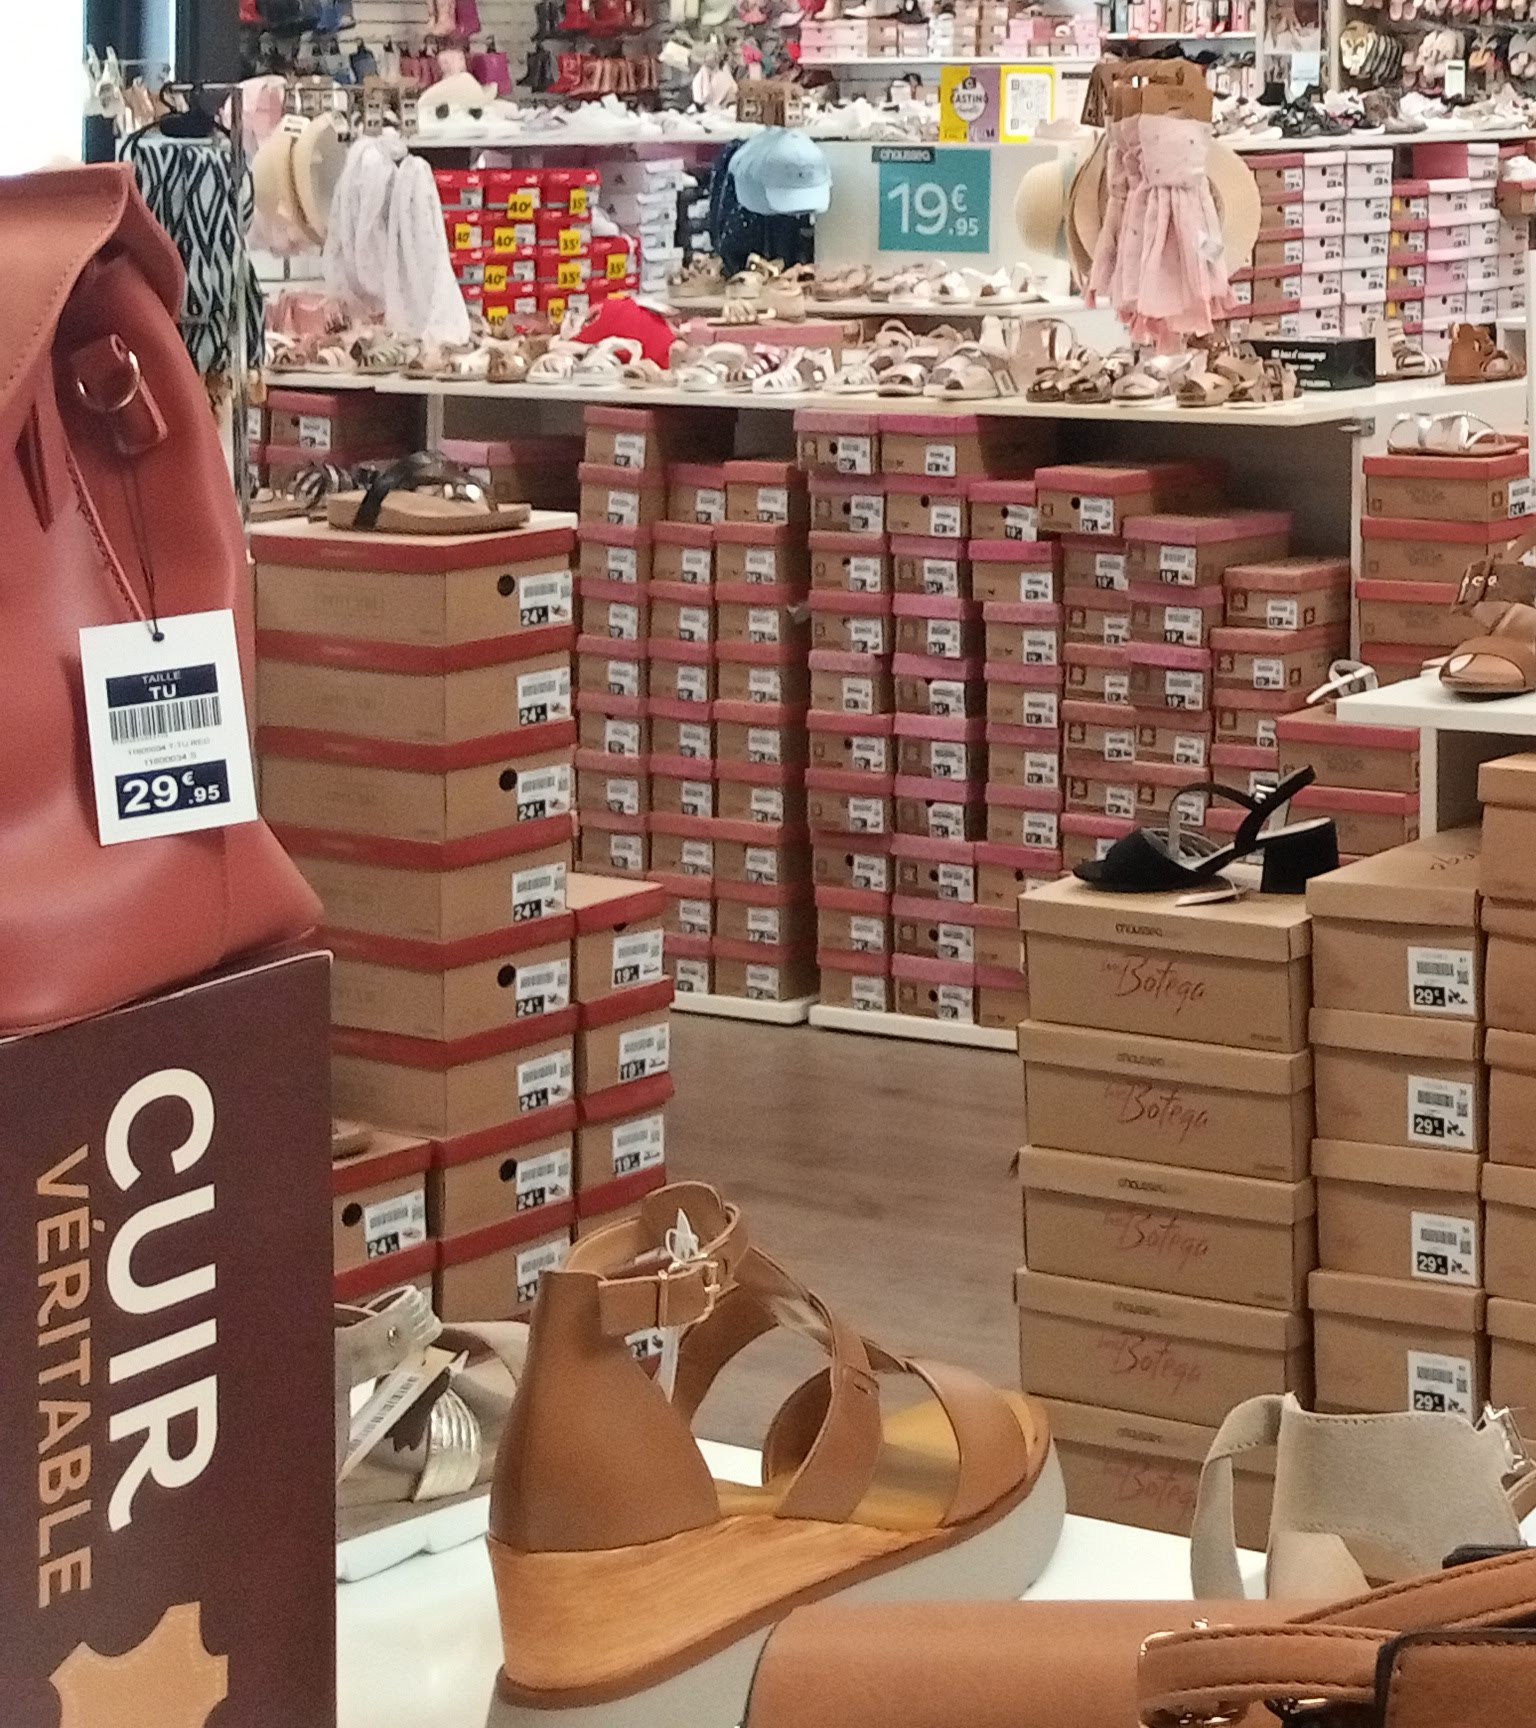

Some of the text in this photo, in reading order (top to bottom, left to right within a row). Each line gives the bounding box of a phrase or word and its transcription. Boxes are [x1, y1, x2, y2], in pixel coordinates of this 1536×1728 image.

[141, 670, 182, 684] TAILLE
[148, 683, 177, 700] TU
[36, 1143, 106, 1609] VÉRITABLE
[104, 1067, 219, 1533] CUIR
